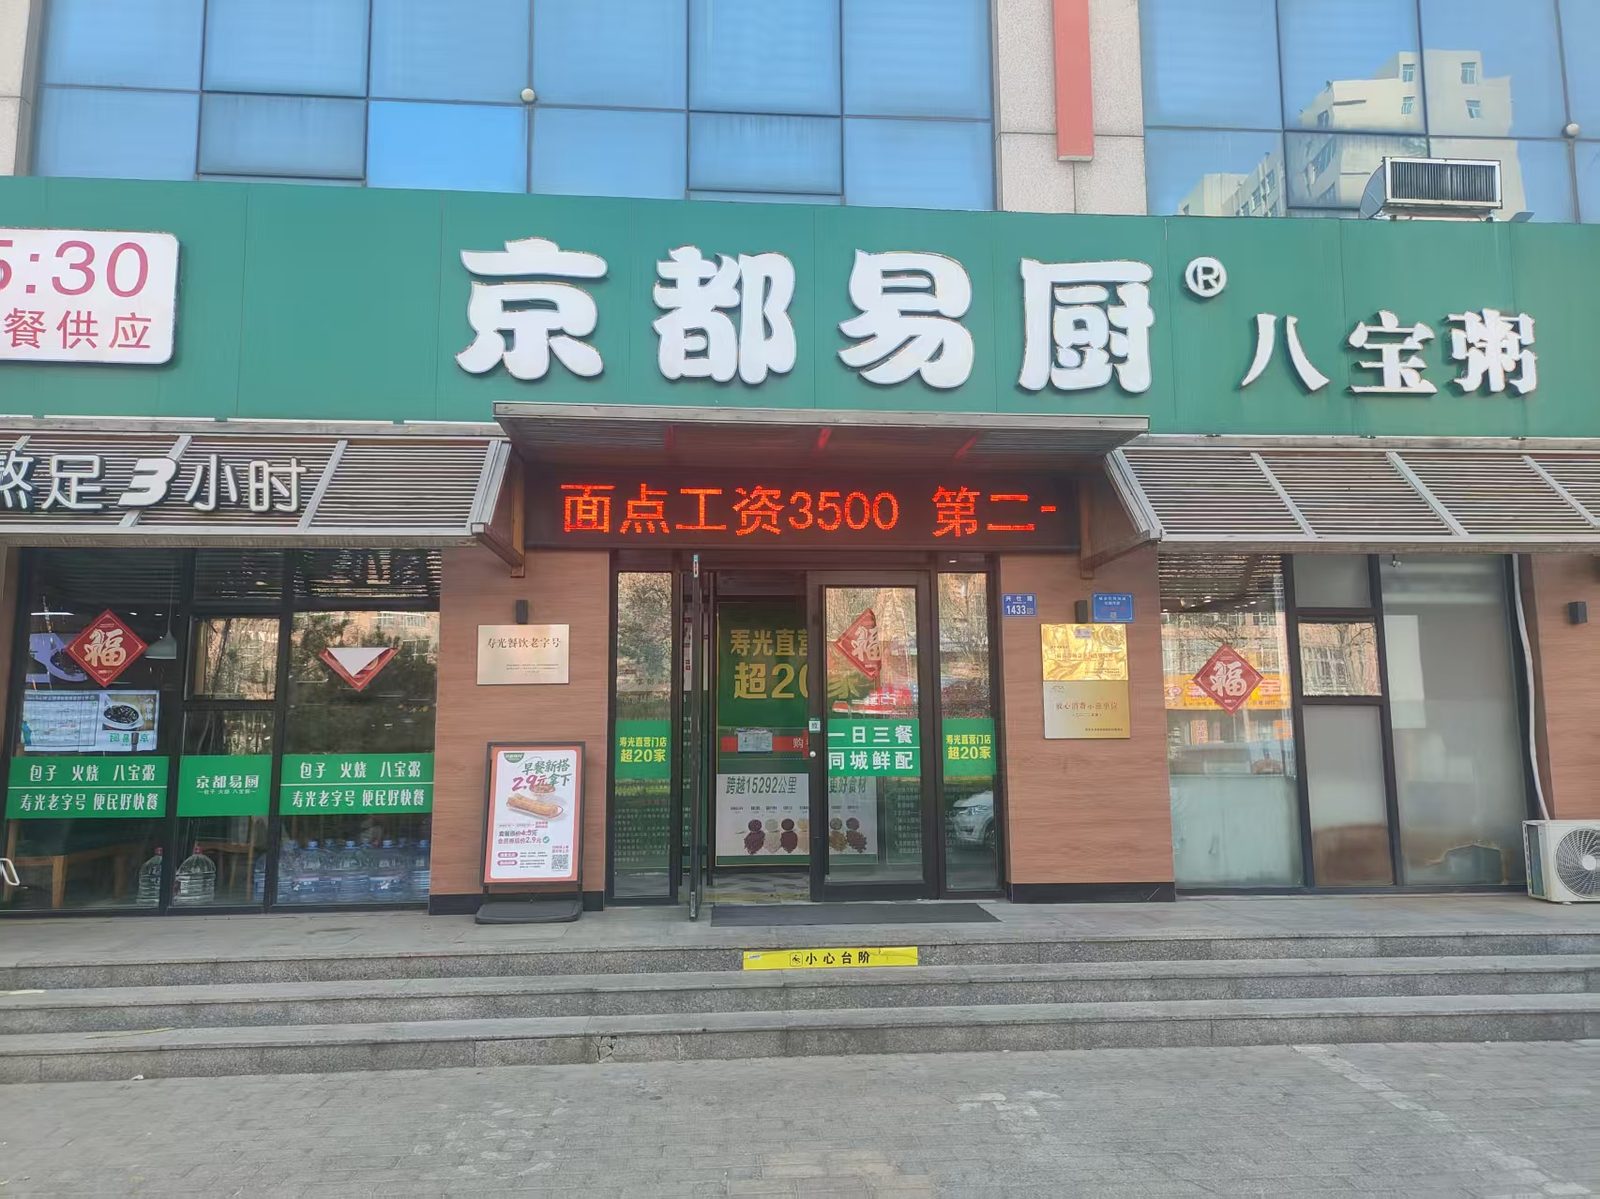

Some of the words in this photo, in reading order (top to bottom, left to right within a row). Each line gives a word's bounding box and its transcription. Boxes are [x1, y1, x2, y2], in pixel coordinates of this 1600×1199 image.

[455, 237, 1155, 394] 京都易厨
[1240, 309, 1537, 395] 八宝粥
[4, 307, 152, 350] 餐供应
[560, 483, 899, 536] 面点工资3500
[1006, 605, 1026, 615] 1433
[84, 628, 126, 667] 福
[487, 637, 560, 649] 寿光餐饮老字号
[1210, 661, 1247, 697] 福
[619, 736, 667, 748] 寿光直营门店
[828, 725, 913, 744] 一日三餐
[946, 734, 991, 745] 寿光直营门店
[620, 748, 666, 763] 超20家
[828, 751, 914, 770] 同城鲜配
[948, 746, 991, 760] 超20家
[30, 764, 57, 782] 包子
[72, 764, 99, 782] 火烧
[113, 764, 156, 781] 八宝粥
[300, 762, 327, 779] 包子
[340, 761, 368, 778] 火烧
[380, 760, 421, 778] 八宝粥
[195, 775, 259, 789] 京都易厨
[726, 776, 797, 794] 跨越15292公里
[20, 793, 86, 811] 寿光老字号
[93, 793, 158, 811] 便民好快餐
[292, 790, 355, 808] 寿光老字号
[362, 789, 424, 806] 便民好快餐
[805, 951, 871, 965] 小心台阶
